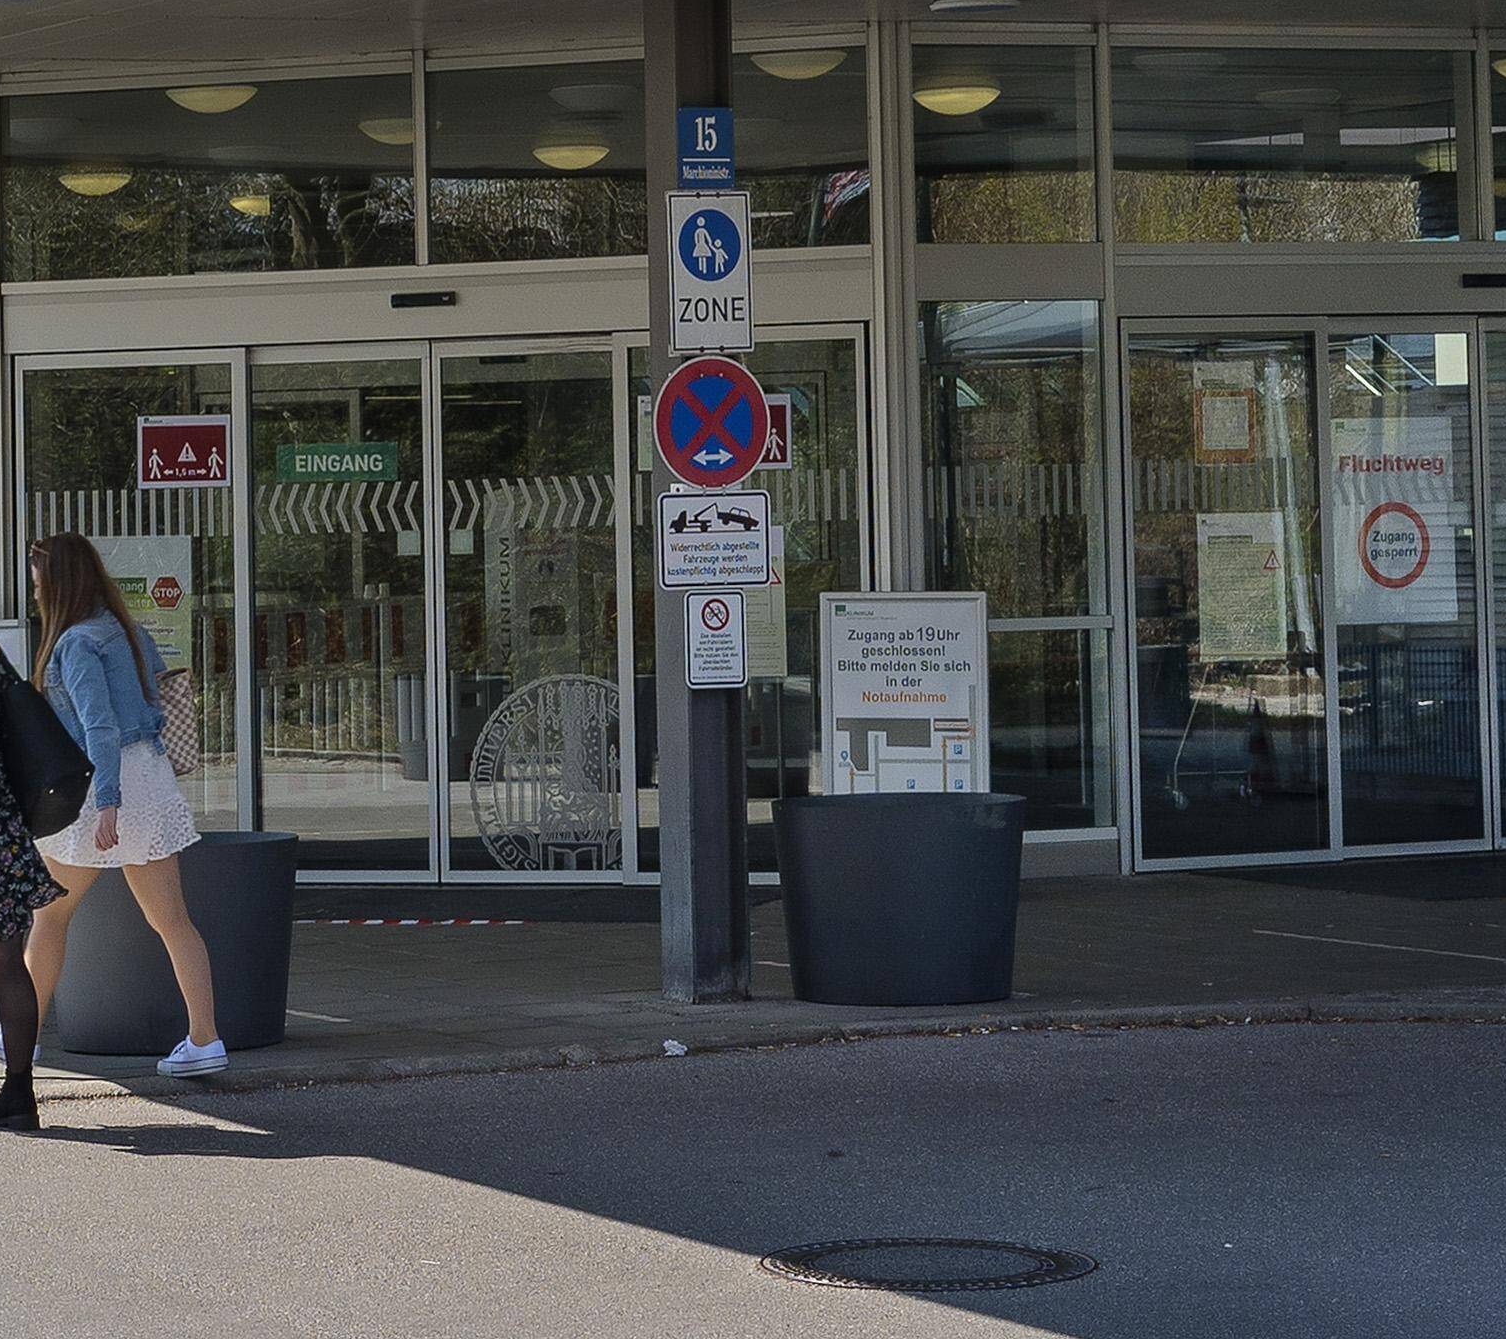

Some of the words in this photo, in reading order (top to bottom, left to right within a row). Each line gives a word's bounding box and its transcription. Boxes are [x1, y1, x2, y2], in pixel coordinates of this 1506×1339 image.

[694, 115, 718, 152] 15
[678, 297, 746, 323] ZONE
[295, 454, 383, 473] EINGANG
[1339, 453, 1444, 476] Fluchtweg
[1372, 530, 1415, 545] Zugang
[683, 554, 720, 564] Fahrzeuge
[1370, 546, 1419, 561] gesperrt
[153, 587, 181, 598] STOP
[498, 537, 512, 666] KLINIKUM
[847, 629, 895, 643] Zugang
[898, 629, 914, 641] ab
[916, 627, 935, 642] 19
[937, 629, 960, 641] Uhr
[861, 645, 946, 659] geschlossen!
[838, 660, 866, 672] Bitte
[870, 660, 917, 672] melden
[920, 660, 940, 672] Sie
[944, 660, 972, 672] sich
[886, 675, 897, 687] in
[901, 675, 922, 687] der
[861, 691, 947, 703] Notaufnahme
